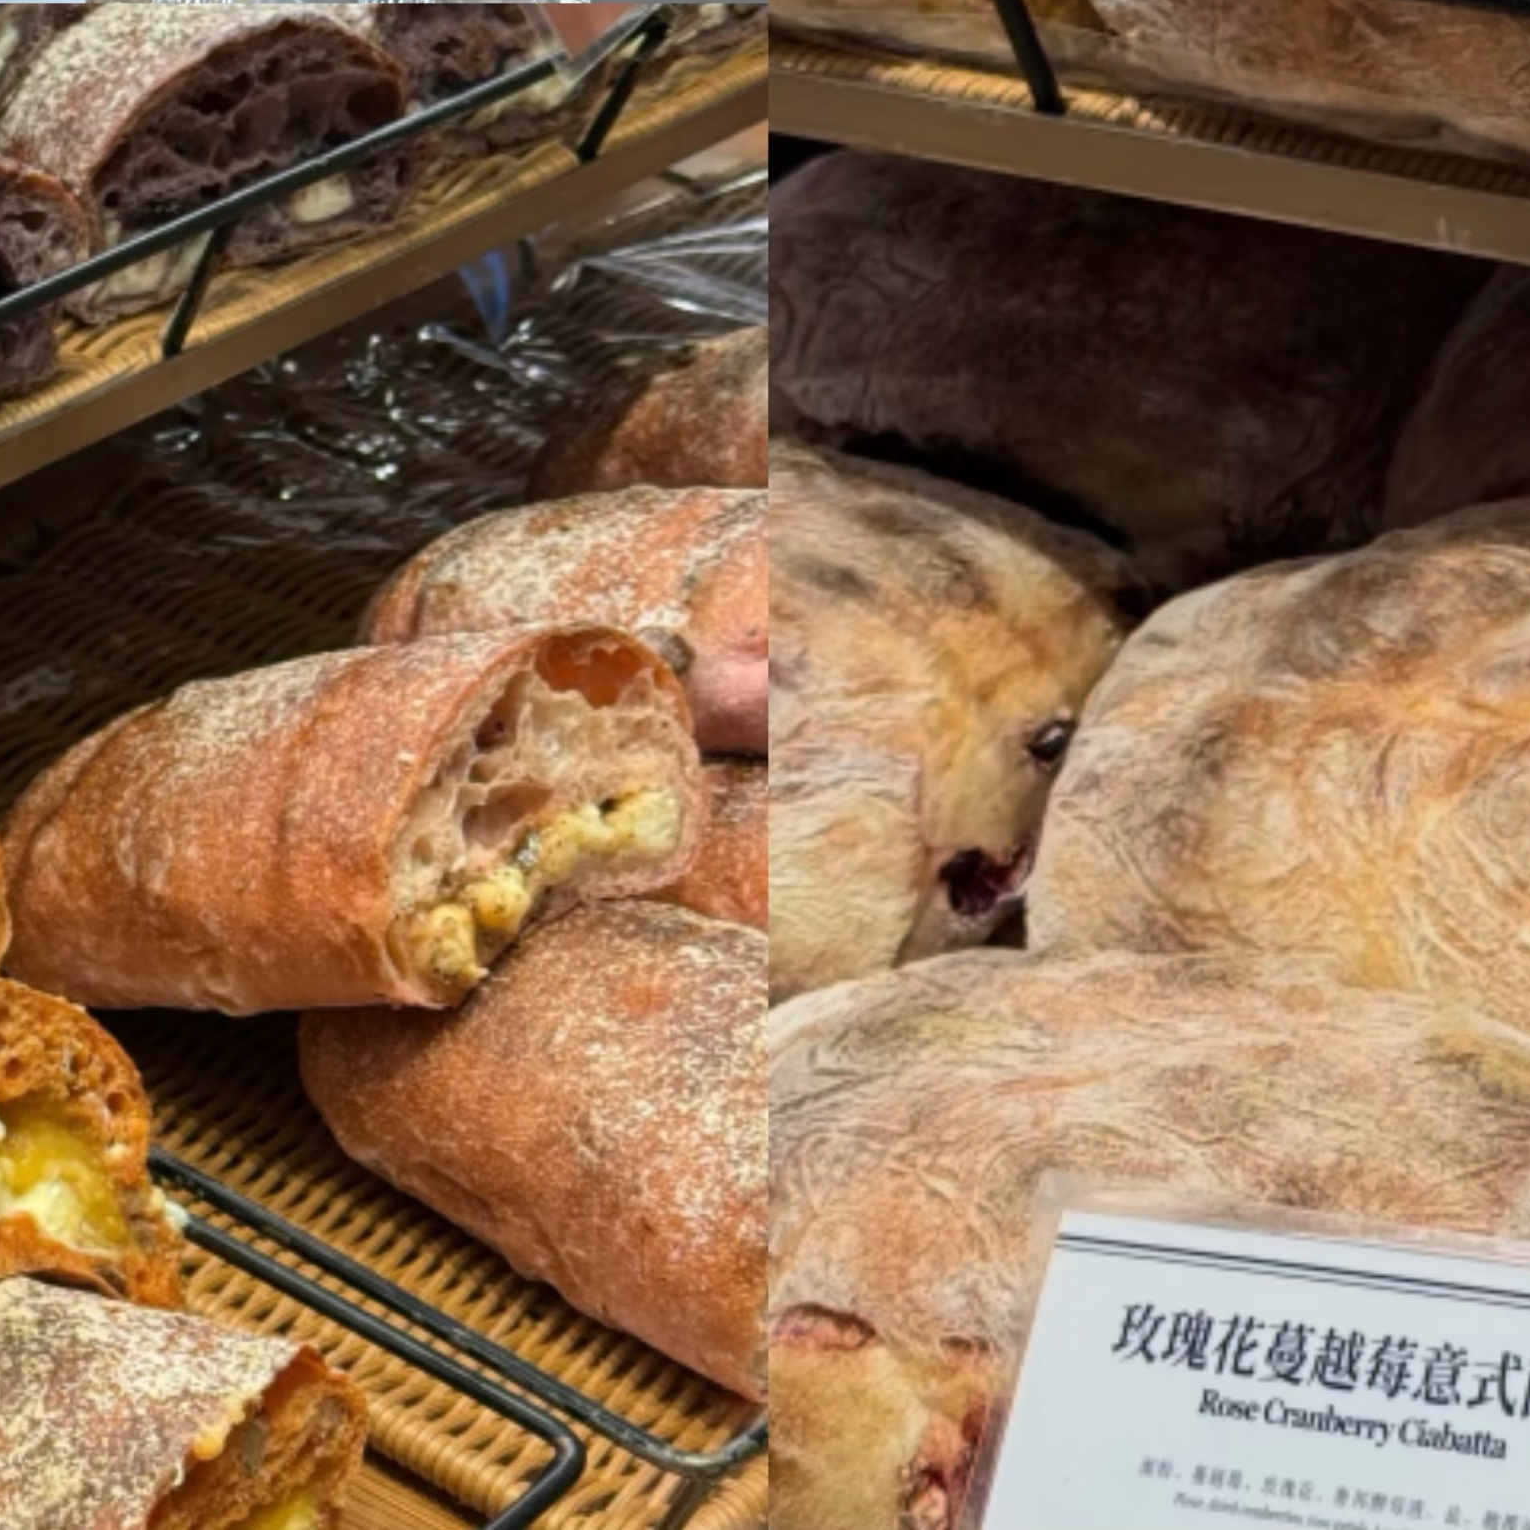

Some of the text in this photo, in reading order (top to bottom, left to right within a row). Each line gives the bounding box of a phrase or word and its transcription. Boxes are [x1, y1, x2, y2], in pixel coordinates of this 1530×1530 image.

[1199, 1388, 1507, 1460] Rose Cranberry Ciabatta
